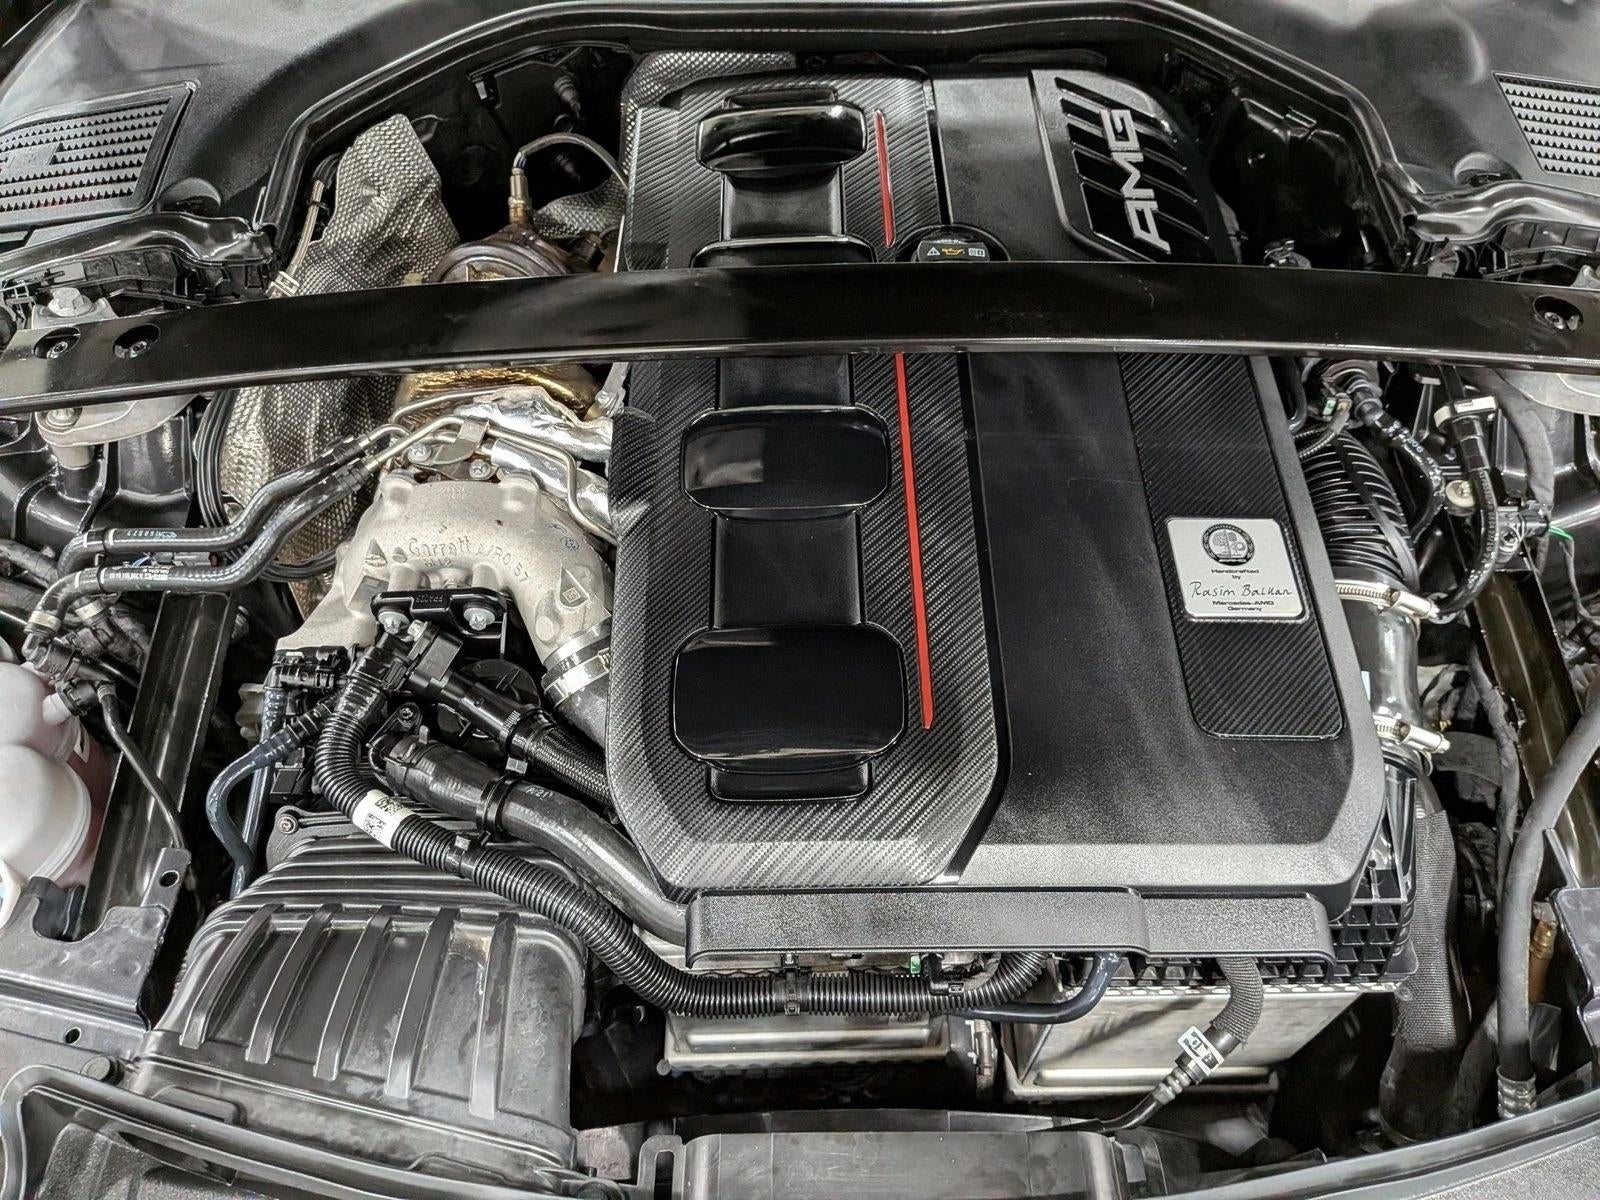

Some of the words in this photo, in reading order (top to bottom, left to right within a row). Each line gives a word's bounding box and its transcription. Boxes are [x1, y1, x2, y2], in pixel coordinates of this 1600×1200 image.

[1100, 108, 1172, 255] AMG
[408, 536, 471, 558] Garrett
[1189, 581, 1236, 598] Rasim
